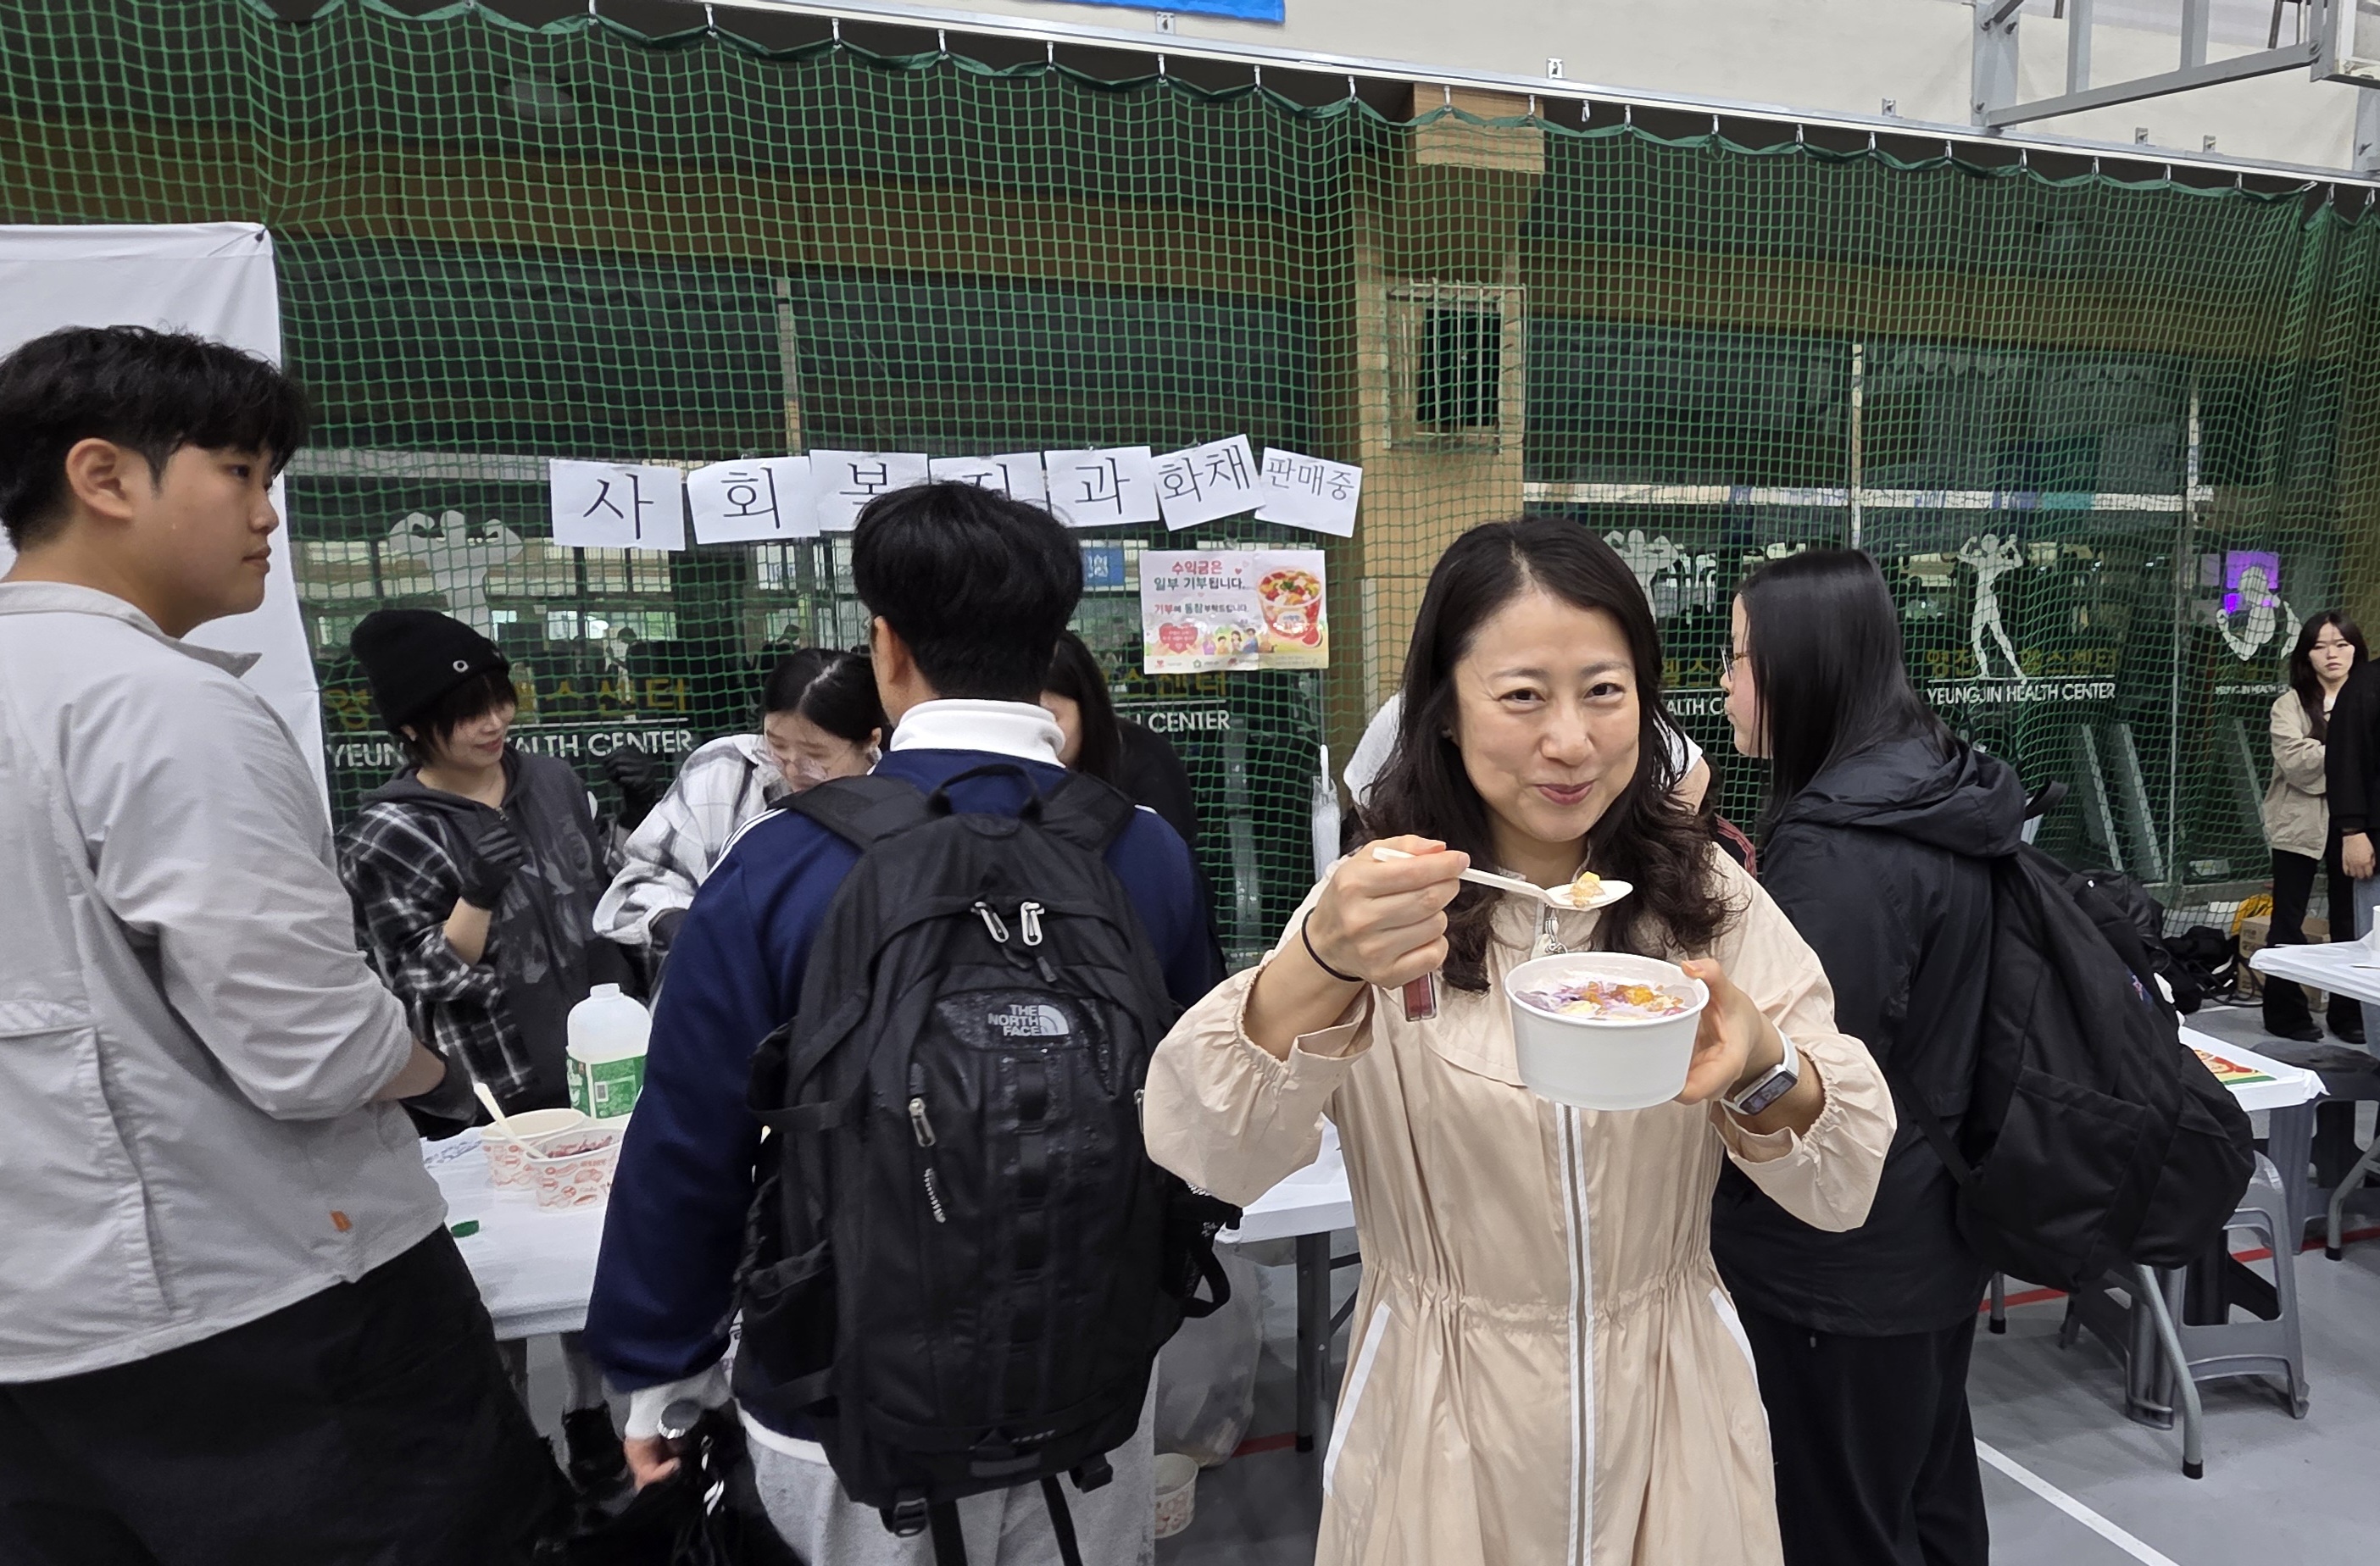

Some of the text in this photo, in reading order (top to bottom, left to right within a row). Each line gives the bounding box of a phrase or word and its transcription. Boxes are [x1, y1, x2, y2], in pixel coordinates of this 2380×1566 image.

[1158, 443, 1251, 504] 화채
[1267, 457, 1355, 502] 판매중
[1171, 559, 1223, 575] 수익금은
[1154, 576, 1247, 591] 일부 기부됩니다.
[1926, 682, 2116, 706] YEUNGJIN HEALTH CENTER
[1148, 709, 1231, 733] CENTER
[1009, 1004, 1038, 1016] THE
[987, 1013, 1039, 1026] NORTH
[1003, 1025, 1040, 1036] FACE
